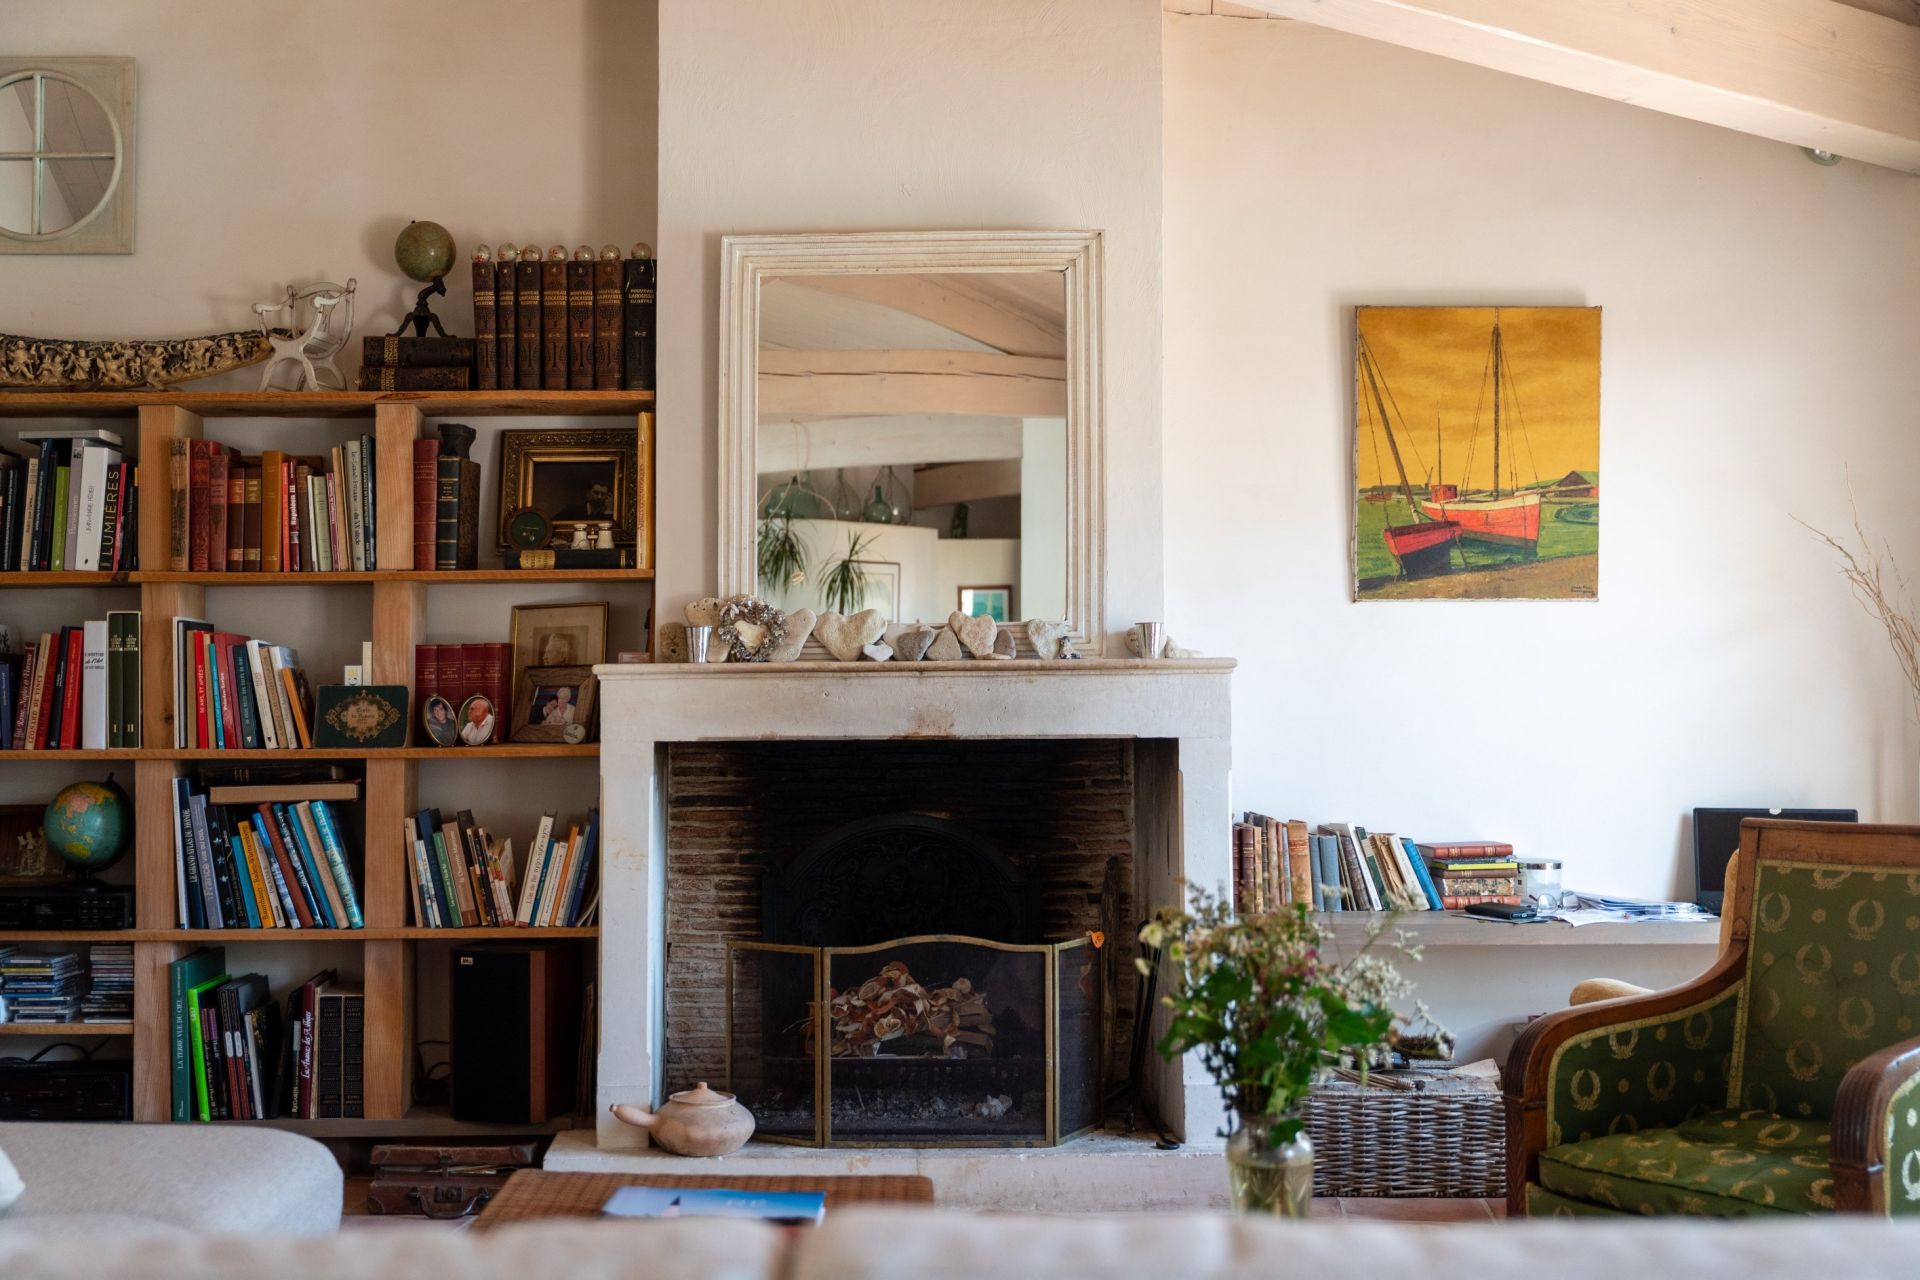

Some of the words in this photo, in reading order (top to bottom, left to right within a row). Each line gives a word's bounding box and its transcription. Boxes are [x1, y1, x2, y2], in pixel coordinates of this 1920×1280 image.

[102, 471, 119, 556] LUMIÈRES
[182, 808, 192, 828] MONDE
[186, 838, 195, 854] ATLAS
[187, 855, 197, 874] GRAND
[190, 875, 198, 883] LE
[202, 863, 213, 896] France
[176, 1014, 183, 1023] DU
[177, 1060, 183, 1069] LA
